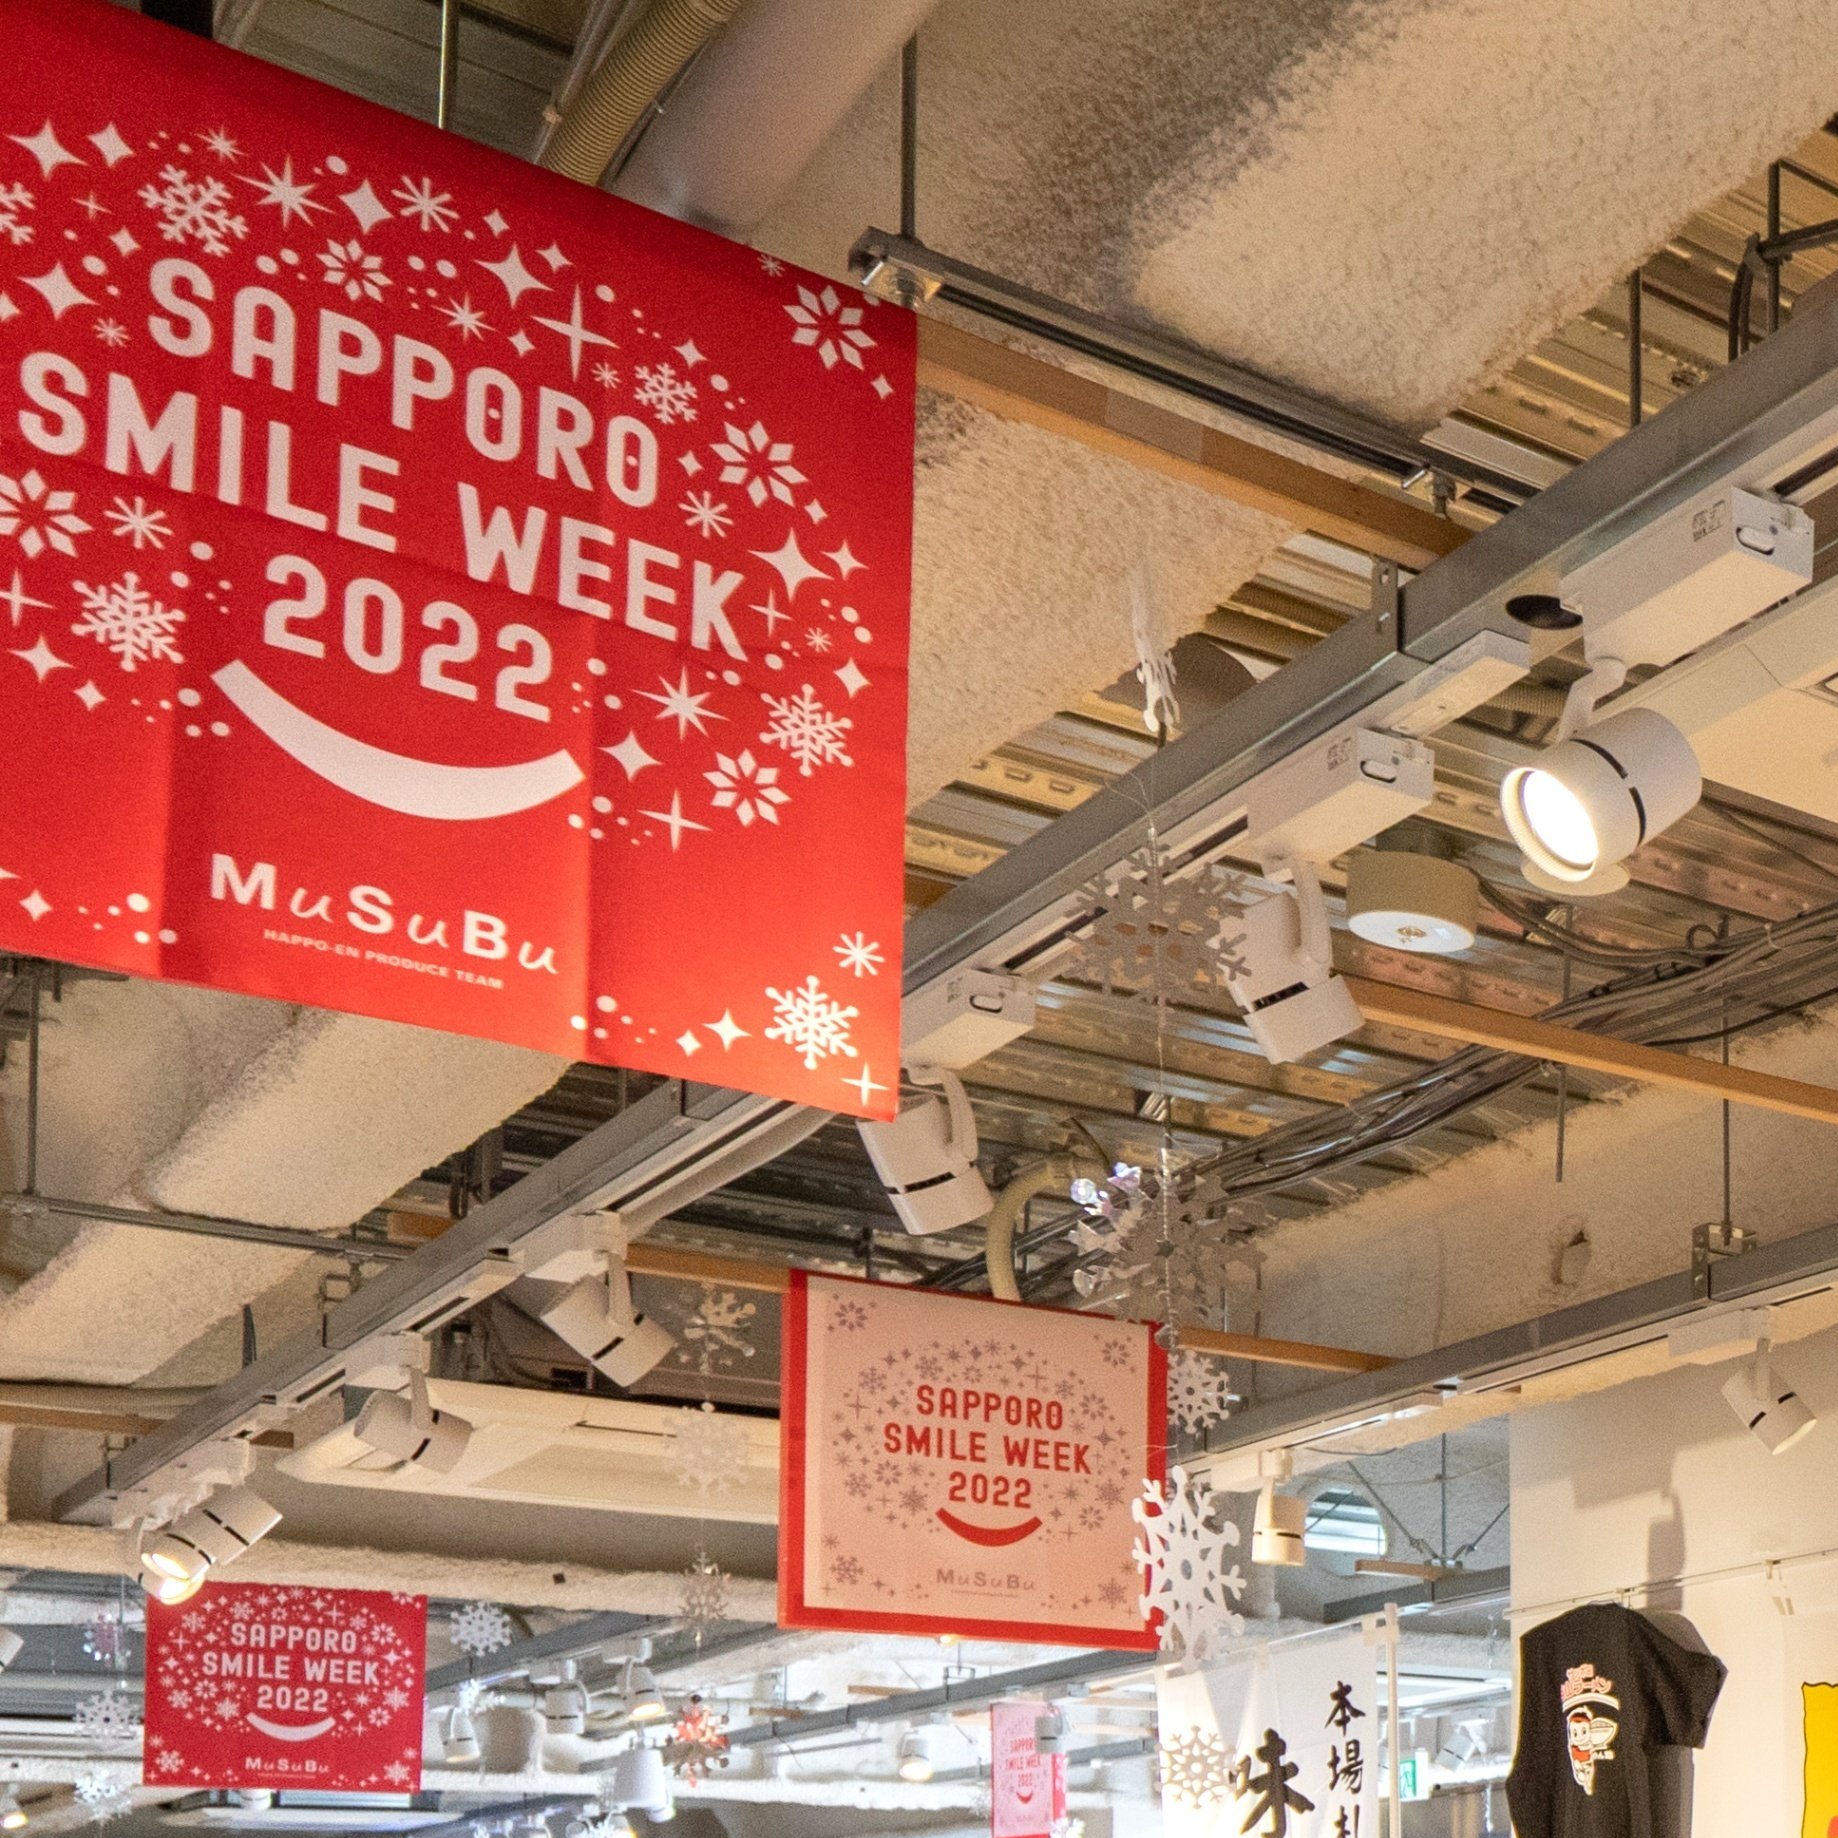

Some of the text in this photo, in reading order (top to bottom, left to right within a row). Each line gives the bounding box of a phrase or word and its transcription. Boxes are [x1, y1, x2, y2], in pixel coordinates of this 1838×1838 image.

[144, 255, 663, 509] SAPPORO
[16, 348, 751, 662] SMILE WEEK
[261, 551, 556, 724] 2022
[211, 852, 559, 974] MuSuBu
[263, 928, 504, 990] HAPPO-EN PRODUCE TEAM
[916, 1384, 1065, 1431] SAPPORO
[883, 1423, 1092, 1475] SMILE WEEK
[948, 1471, 1033, 1508] 2022
[935, 1567, 1037, 1592] MuSuBu
[229, 1621, 358, 1654] SAPPORO
[200, 1650, 380, 1685] SMILE WEEK
[256, 1685, 330, 1713] 2022
[243, 1756, 330, 1774] MuSuBu
